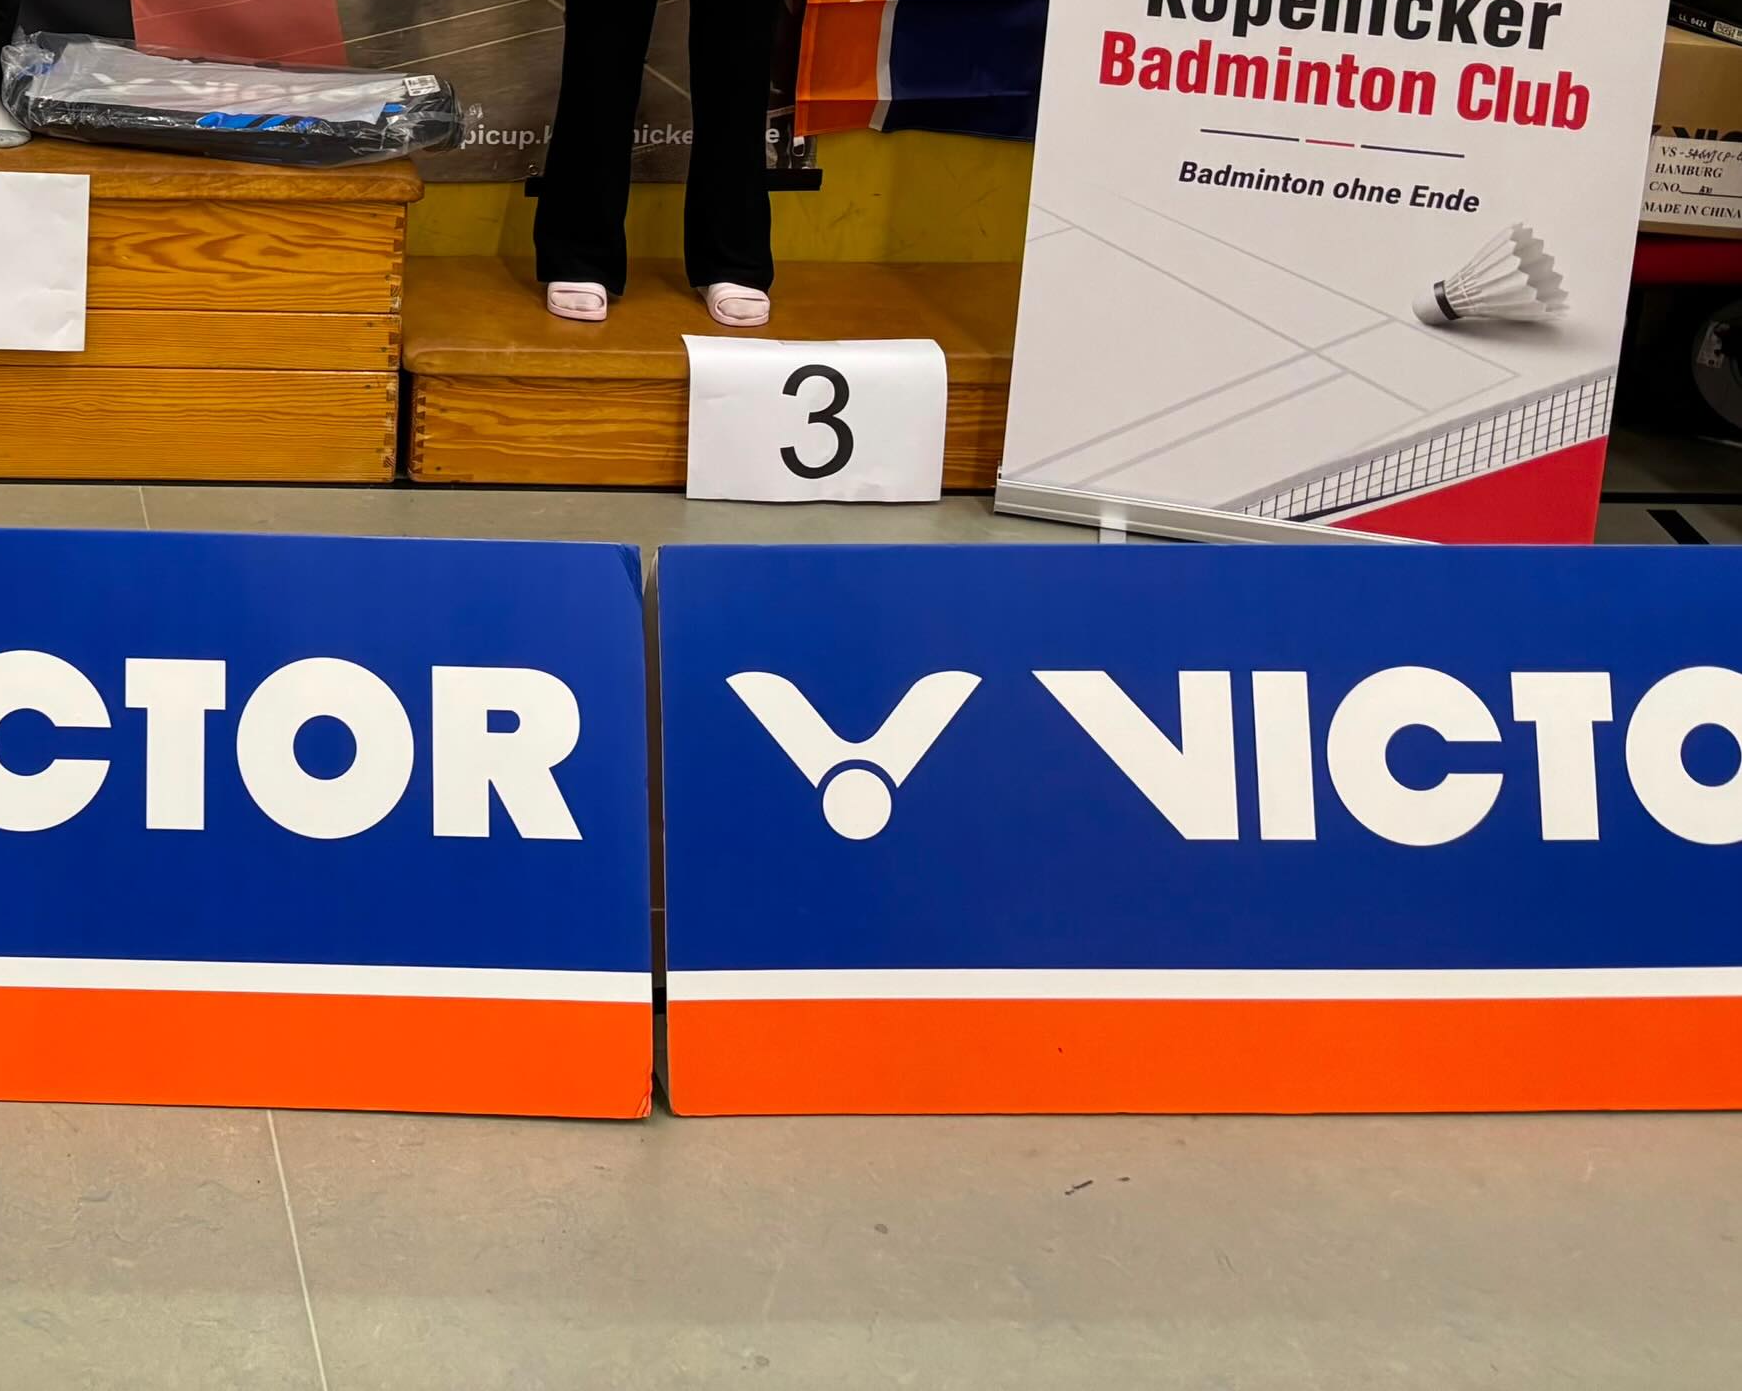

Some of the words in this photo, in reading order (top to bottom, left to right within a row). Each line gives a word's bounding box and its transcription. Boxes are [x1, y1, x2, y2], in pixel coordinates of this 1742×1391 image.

[1098, 30, 1437, 116] Badminton
[1457, 62, 1591, 131] Club
[1178, 161, 1324, 196] Badminton
[1333, 178, 1402, 207] ohne
[1410, 185, 1481, 214] Ende
[1655, 163, 1723, 178] HAMBURG
[1643, 201, 1682, 214] MADE
[1684, 204, 1698, 215] IN
[1701, 206, 1742, 219] CHINA
[779, 364, 855, 480] 3
[1031, 666, 1742, 847] VICTO
